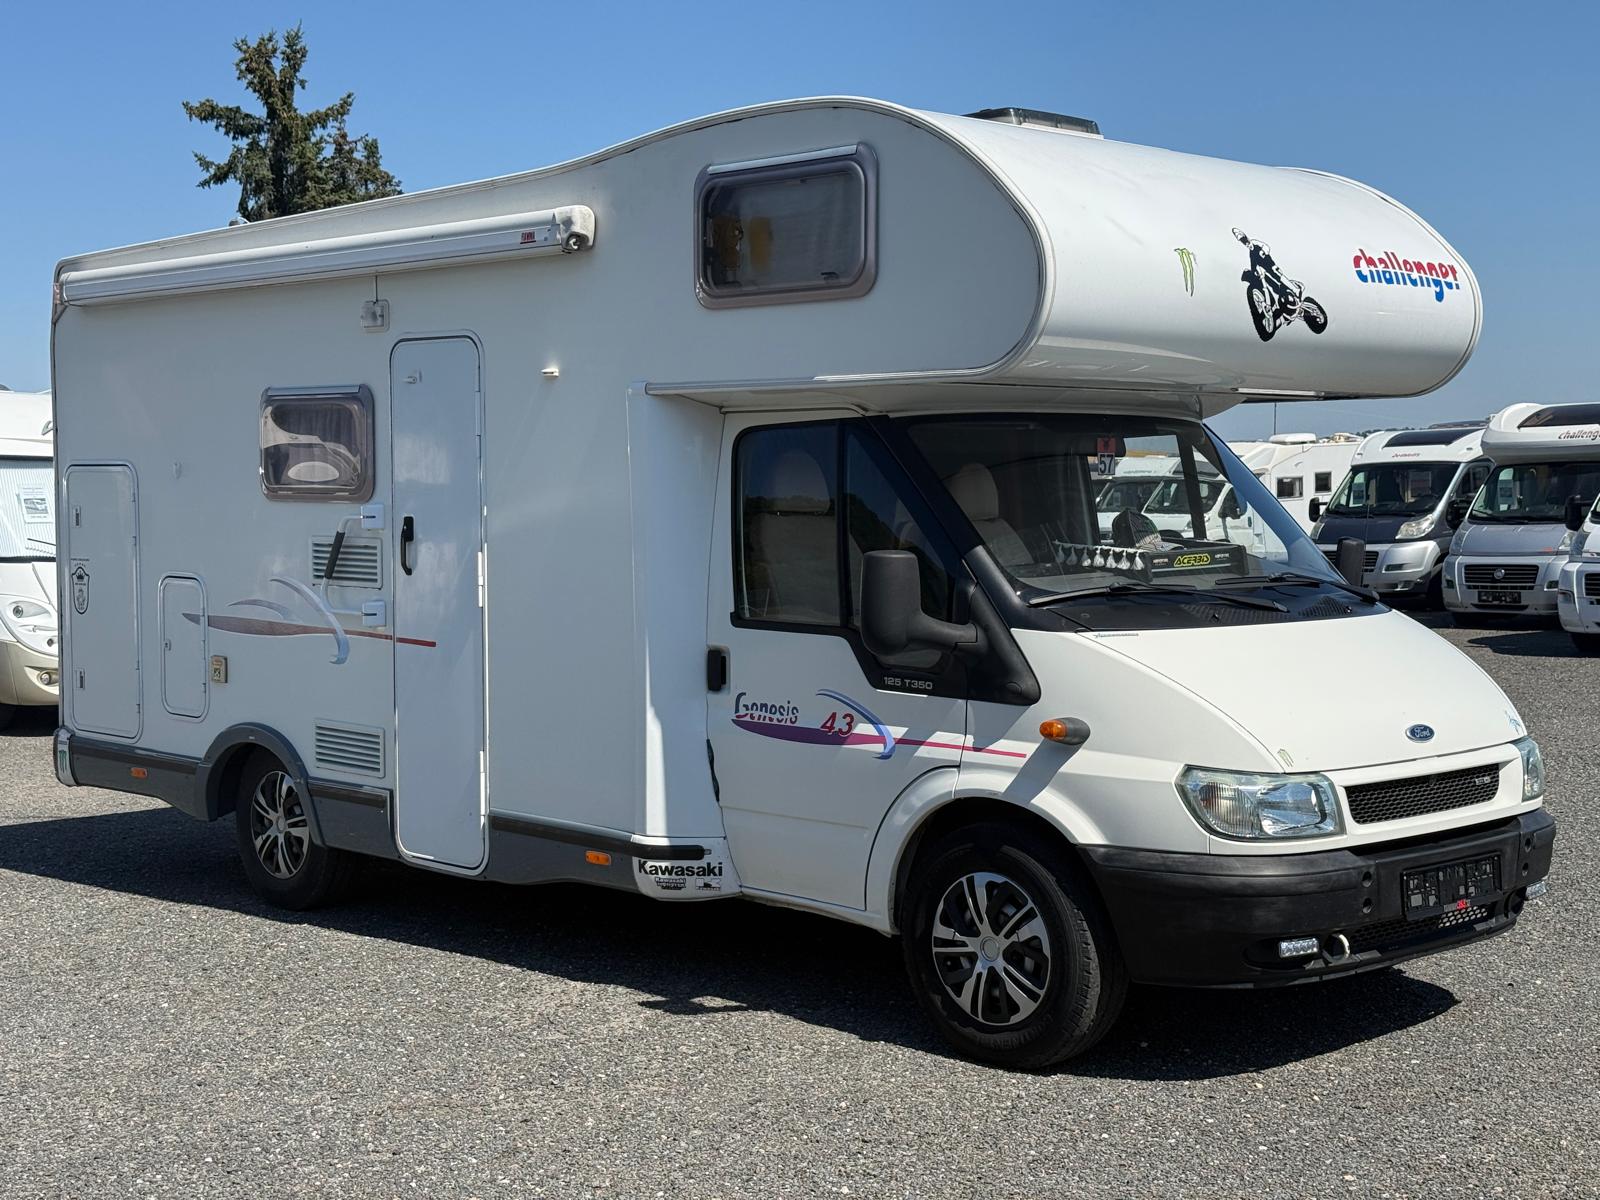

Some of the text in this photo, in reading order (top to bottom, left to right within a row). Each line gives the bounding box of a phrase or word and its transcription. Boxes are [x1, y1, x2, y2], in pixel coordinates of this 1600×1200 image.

[1558, 430, 1600, 441] challeng
[1099, 454, 1114, 474] 57
[883, 676, 933, 690] 125 T350
[734, 692, 799, 725] Genesis
[820, 711, 855, 736] 43
[638, 860, 723, 877] Kawasaki
